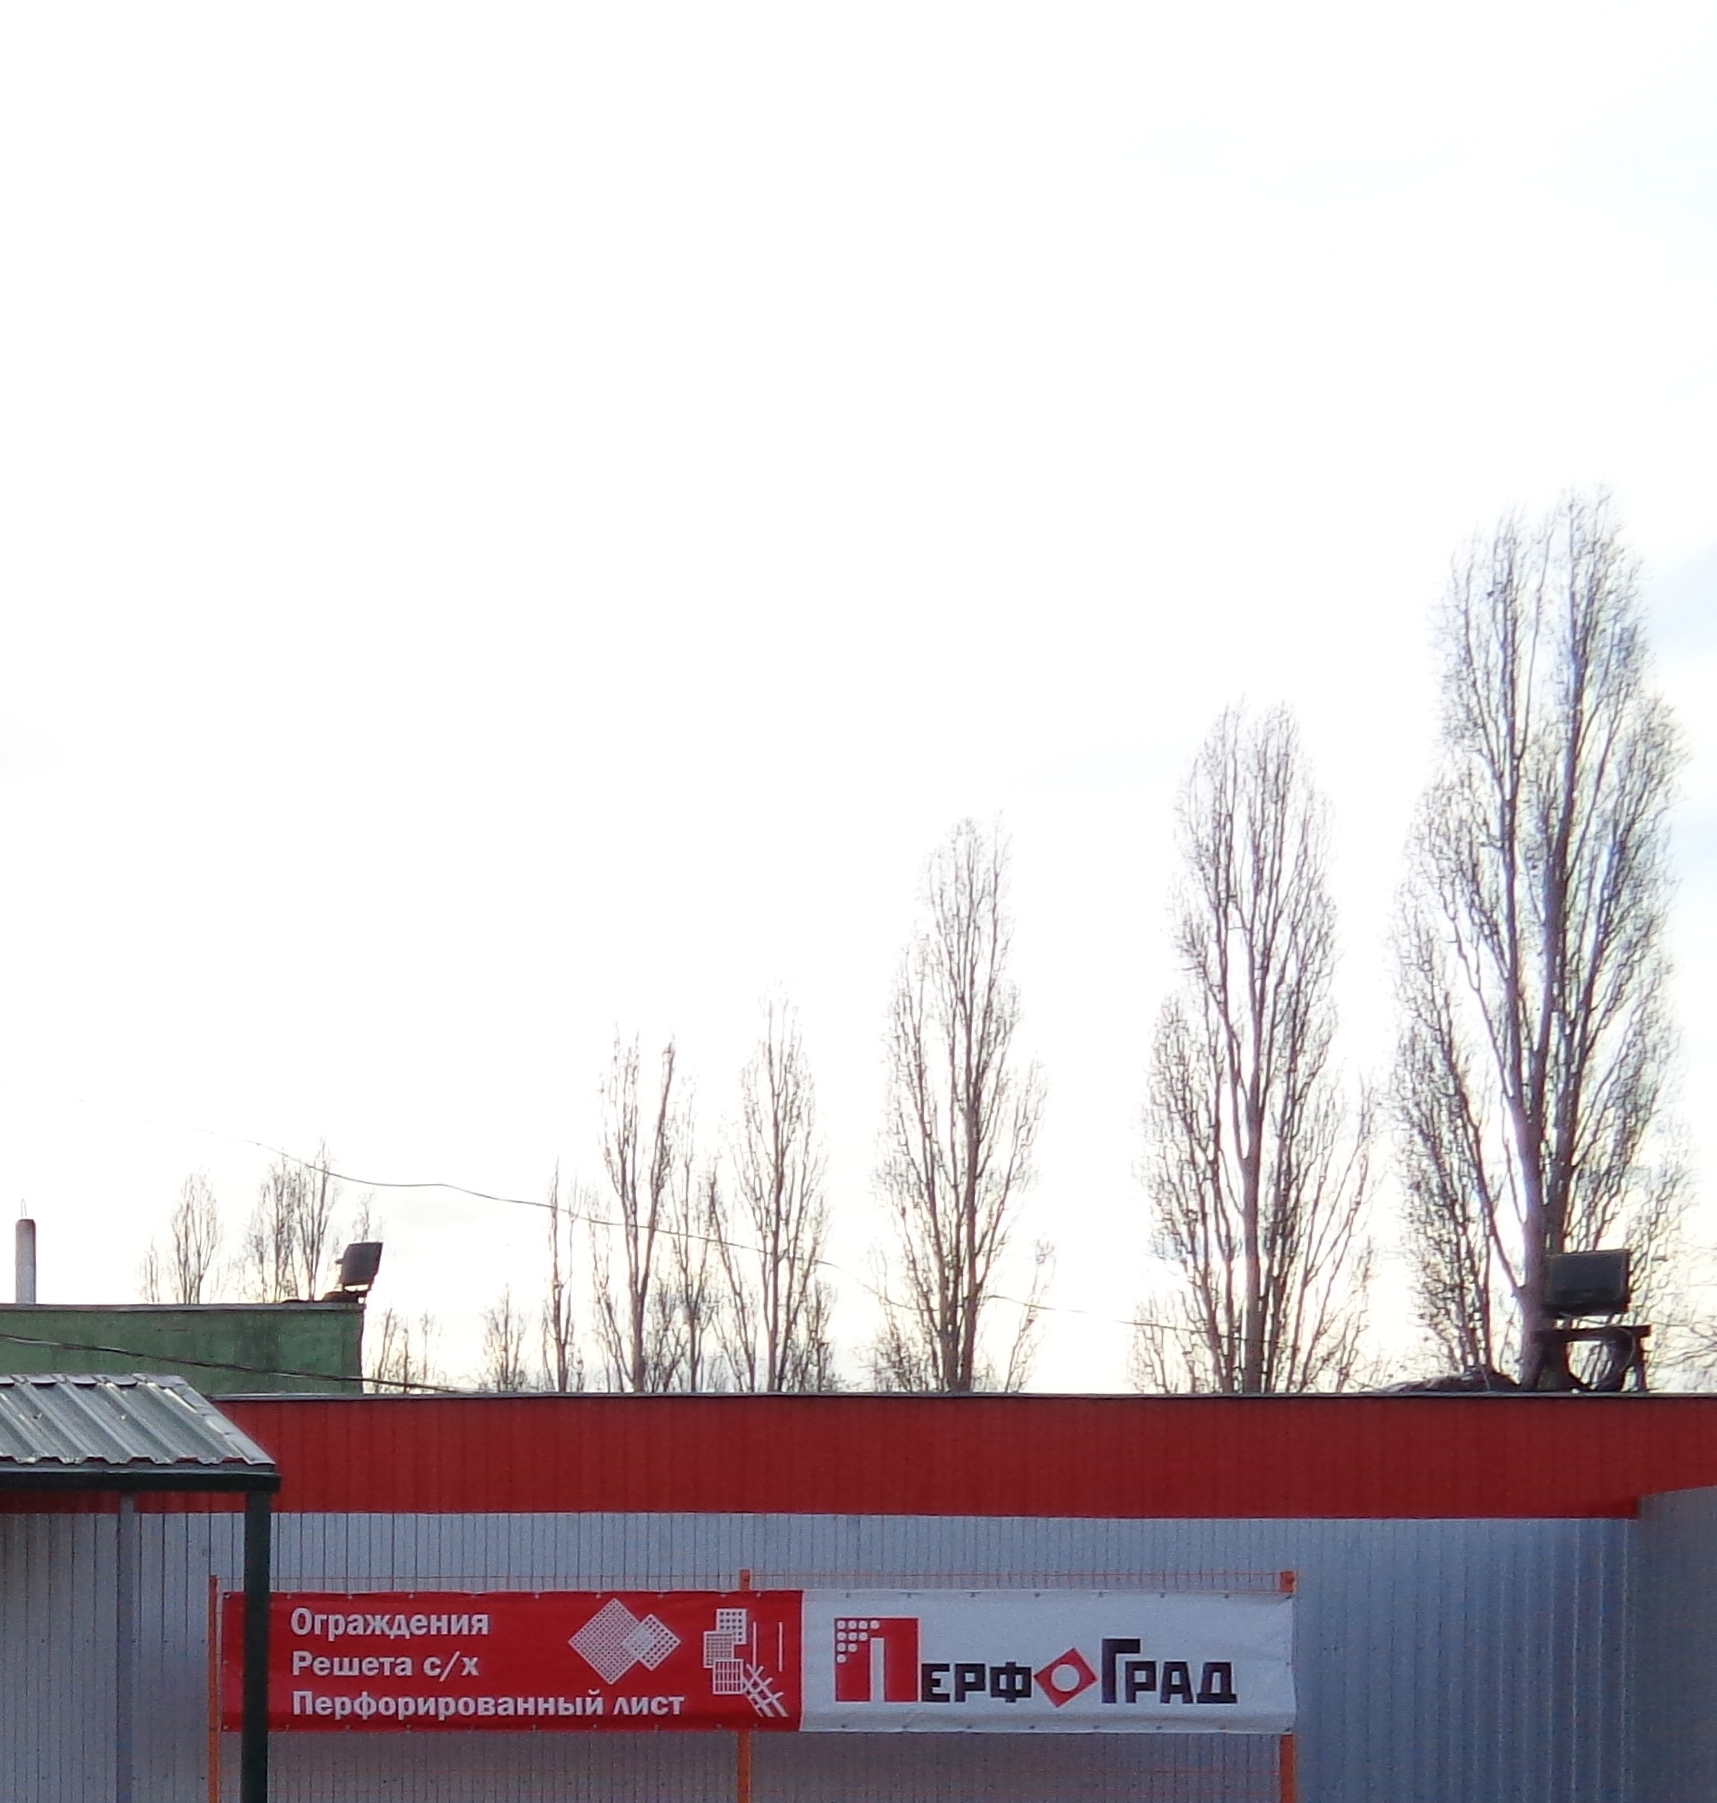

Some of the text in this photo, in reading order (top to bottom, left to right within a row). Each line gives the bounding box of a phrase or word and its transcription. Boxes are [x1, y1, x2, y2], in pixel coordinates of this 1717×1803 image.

[290, 1608, 489, 1640] Ограждения
[291, 1650, 479, 1681] Решета с/х
[292, 1689, 684, 1721] Перфорированный лист
